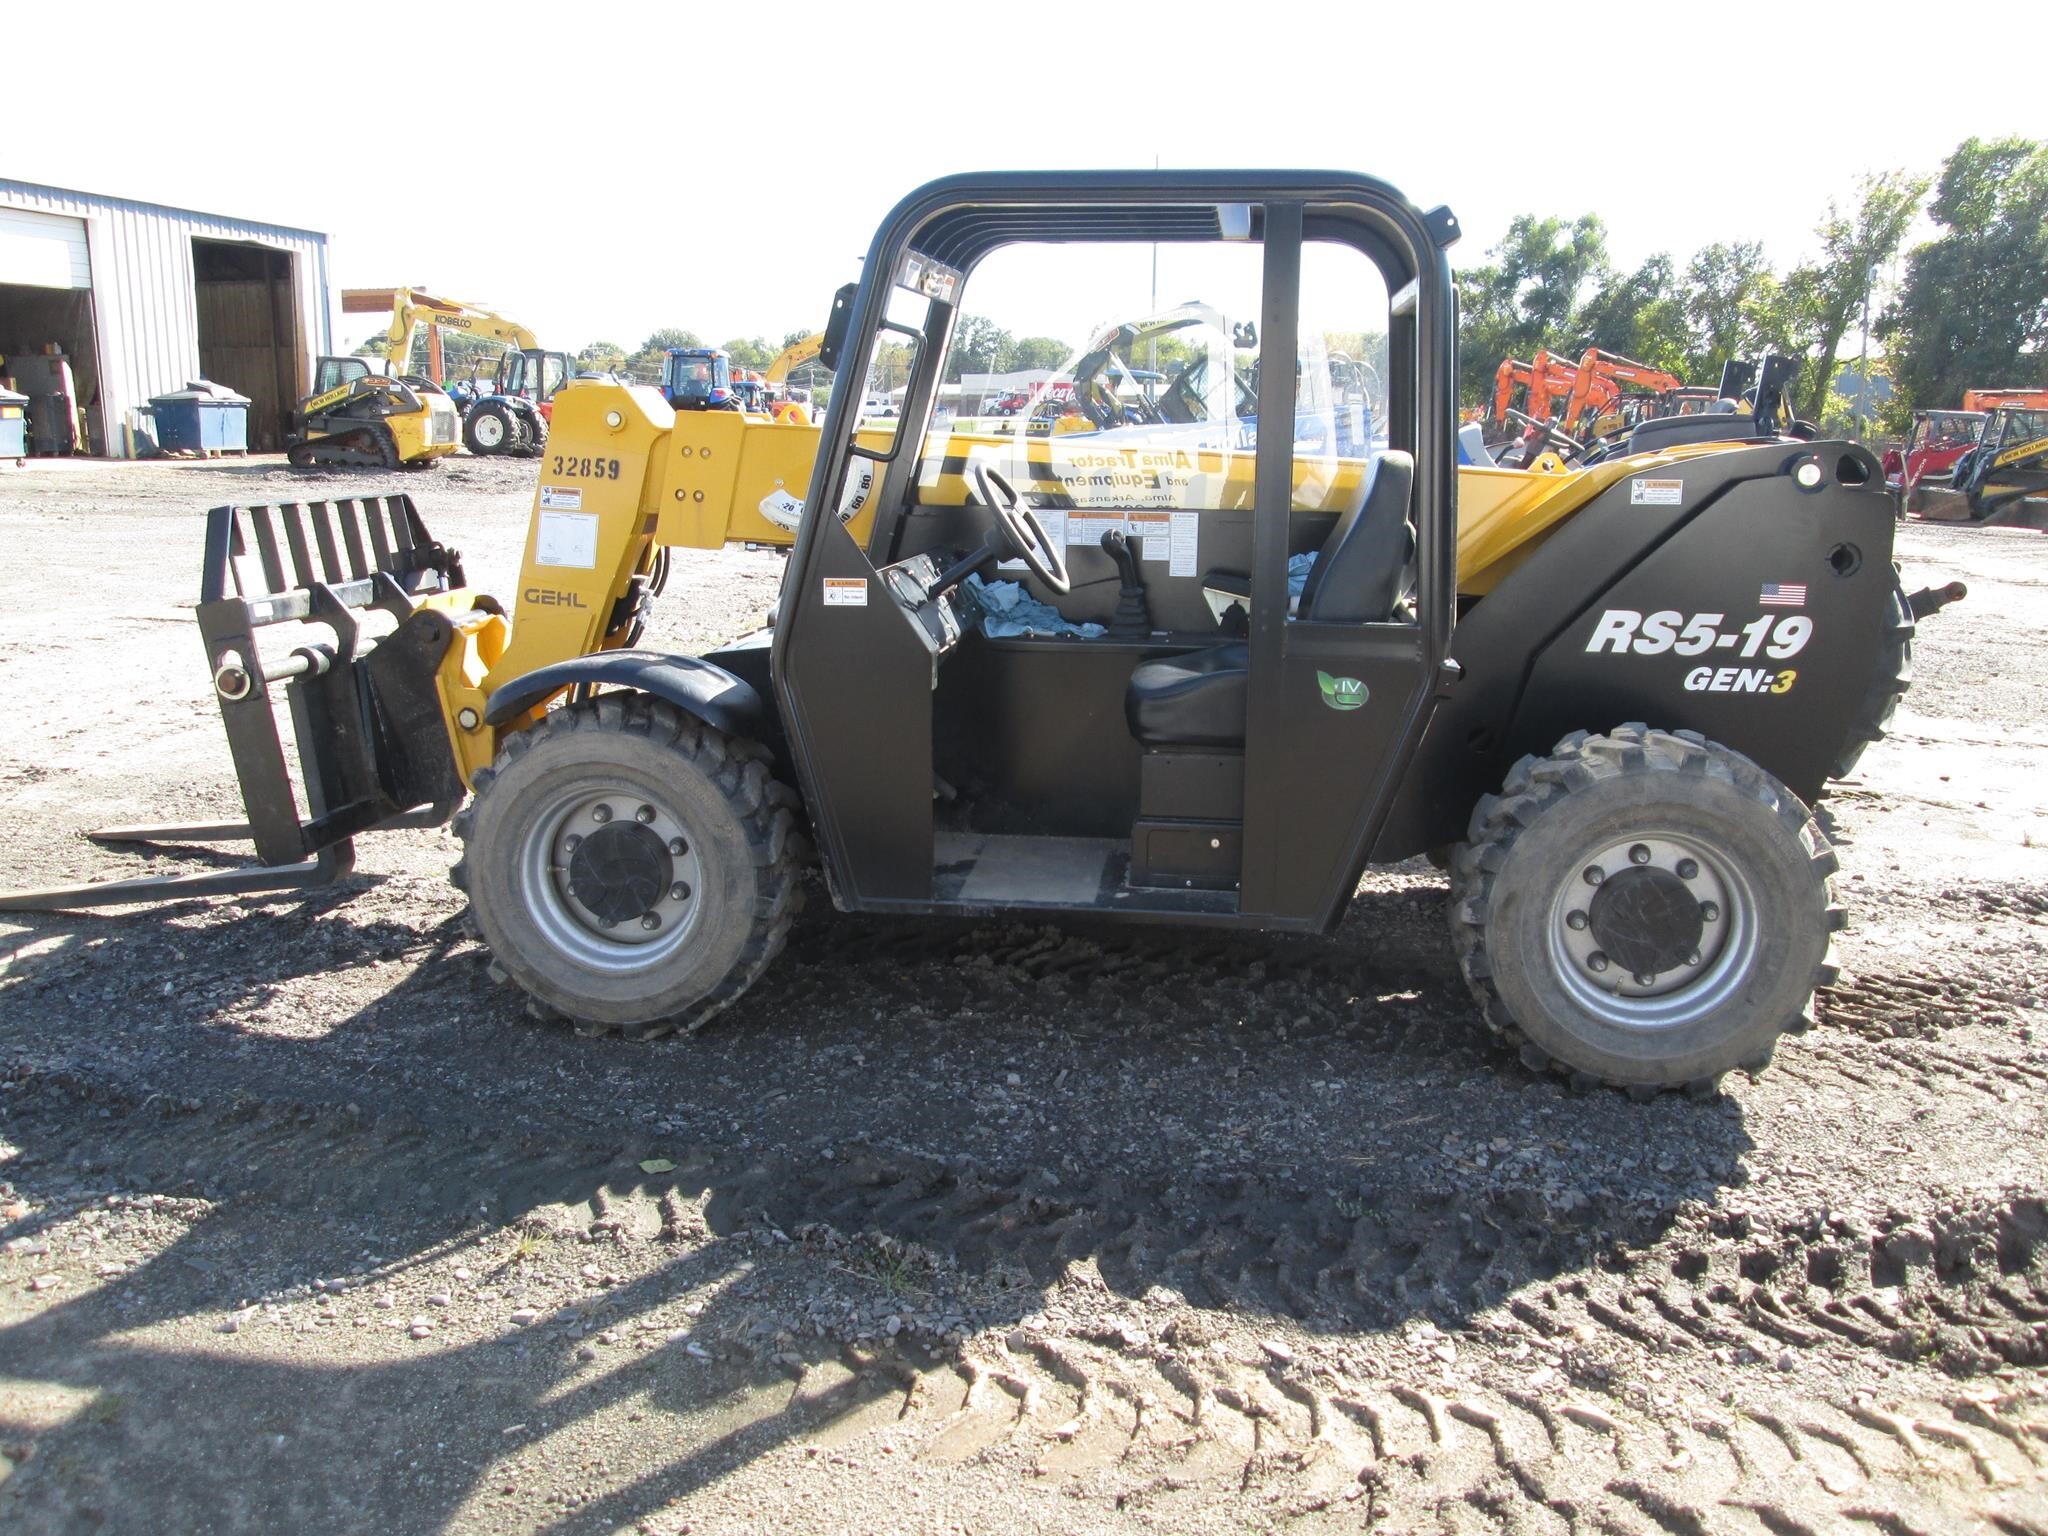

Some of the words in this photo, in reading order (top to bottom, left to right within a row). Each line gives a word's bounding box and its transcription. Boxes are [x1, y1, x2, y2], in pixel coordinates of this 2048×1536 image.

[434, 314, 472, 328] KOBELCO
[553, 455, 620, 480] 32859
[861, 474, 872, 490] 80
[851, 495, 865, 510] 60
[524, 588, 588, 609] GEHL
[1585, 610, 1814, 660] RS5-19
[1683, 667, 1798, 694] GEN:3
